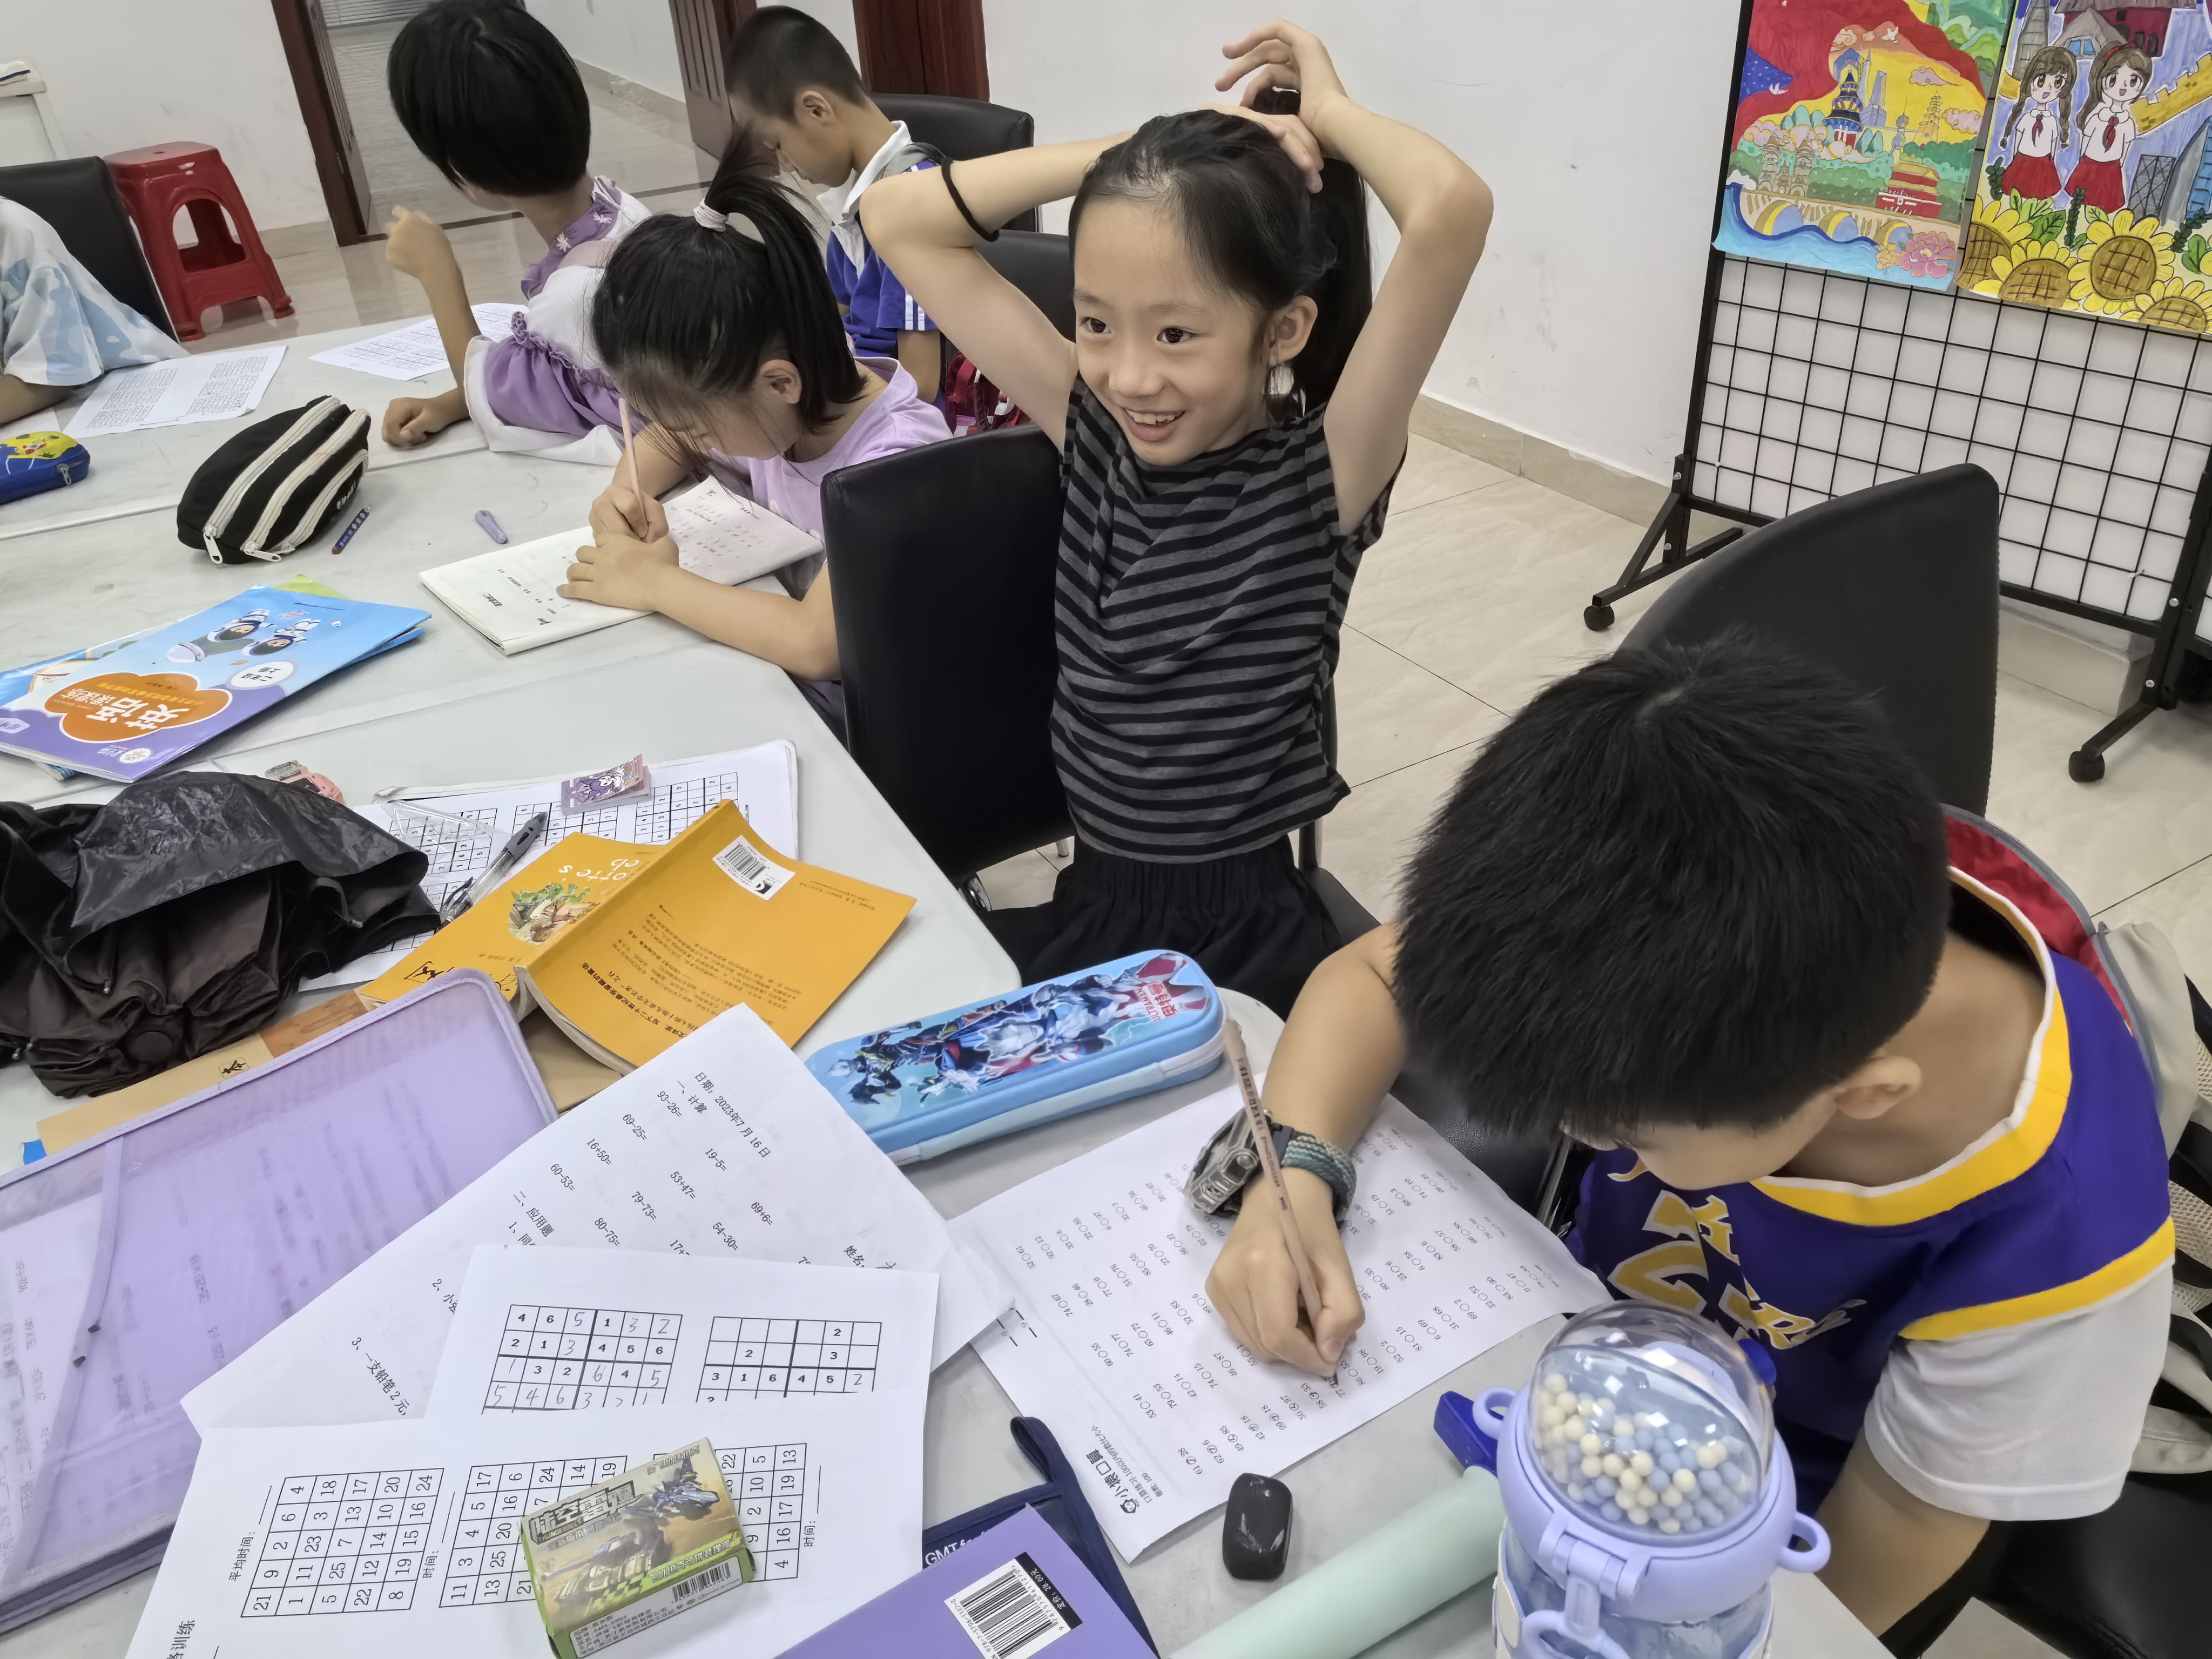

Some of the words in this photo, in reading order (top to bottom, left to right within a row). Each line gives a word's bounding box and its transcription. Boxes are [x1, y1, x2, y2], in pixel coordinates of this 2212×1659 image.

[86, 697, 190, 730] 英语
[1136, 988, 1161, 1021] ULTRAMAN
[1148, 983, 1177, 1016] 奥特曼
[657, 1091, 682, 1117] 93-26=
[705, 1148, 727, 1171] 19-5=
[623, 1114, 647, 1140] 69-25=
[670, 1171, 696, 1199] 53+47=
[751, 1202, 773, 1225] 69+6=
[586, 1138, 612, 1165] 16+50=
[631, 1191, 656, 1220] 79-73=
[712, 1222, 738, 1251] 54-30=
[550, 1164, 575, 1191] 60-53=
[594, 1217, 620, 1246] 80-75=
[670, 1239, 690, 1256] 17+
[508, 1222, 535, 1246] 1、同
[518, 1313, 526, 1322] 4
[546, 1314, 554, 1324] 6
[604, 1318, 610, 1327] 1
[629, 1318, 638, 1333] 3
[833, 1328, 841, 1337] 2
[511, 1338, 520, 1347] 2
[541, 1340, 547, 1349] 1
[563, 1340, 576, 1355] 3
[598, 1343, 606, 1352] 4
[626, 1345, 635, 1354] 5
[655, 1346, 664, 1355] 6
[745, 1349, 753, 1358] 2
[830, 1351, 838, 1360] 3
[533, 1365, 542, 1374] 3
[562, 1367, 571, 1376] 2
[621, 1370, 629, 1378] 4
[711, 1372, 720, 1381] 3
[740, 1373, 747, 1381] 1
[768, 1374, 777, 1382] 6
[798, 1374, 805, 1383] 4
[826, 1375, 834, 1384] 5
[526, 1388, 538, 1406] 4
[721, 1454, 736, 1469] 22
[782, 1449, 797, 1465] 13
[508, 1473, 523, 1481] 6
[570, 1465, 586, 1480] 14
[602, 1462, 616, 1478] 19
[1085, 1448, 1130, 1498] 小猿口算
[1141, 1472, 1152, 1483] 100
[352, 1479, 368, 1494] 17
[384, 1476, 401, 1493] 20
[416, 1475, 433, 1491] 24
[476, 1472, 491, 1487] 17
[750, 1477, 764, 1493] 10
[780, 1475, 795, 1491] 19
[320, 1480, 337, 1496] 18
[409, 1502, 426, 1518] 16
[470, 1502, 485, 1510] 5
[502, 1495, 518, 1512] 16
[747, 1507, 761, 1515] 2
[778, 1501, 793, 1517] 17
[313, 1512, 328, 1520] 3
[345, 1506, 361, 1522] 13
[377, 1504, 394, 1520] 10
[402, 1530, 419, 1547] 15
[464, 1529, 480, 1538] 4
[496, 1522, 512, 1539] 20
[516, 1585, 532, 1595] 21
[538, 1466, 555, 1483] 24
[746, 1534, 759, 1543] 9
[776, 1528, 791, 1544] 16
[253, 1595, 272, 1610] 21
[264, 1570, 279, 1579] 9
[273, 1541, 288, 1550] 2
[281, 1513, 296, 1522] 6
[289, 1486, 305, 1494] 4
[304, 1536, 321, 1553] 23
[338, 1539, 352, 1547] 7
[369, 1532, 387, 1549] 14
[395, 1559, 412, 1575] 19
[458, 1557, 473, 1567] 3
[489, 1551, 507, 1568] 25
[774, 1559, 788, 1569] 4
[296, 1565, 314, 1581] 11
[328, 1562, 346, 1579] 25
[362, 1560, 380, 1577] 12
[388, 1591, 404, 1600] 8
[451, 1583, 468, 1600] 11
[484, 1580, 501, 1597] 13
[321, 1595, 337, 1603] 5
[354, 1588, 372, 1606] 22
